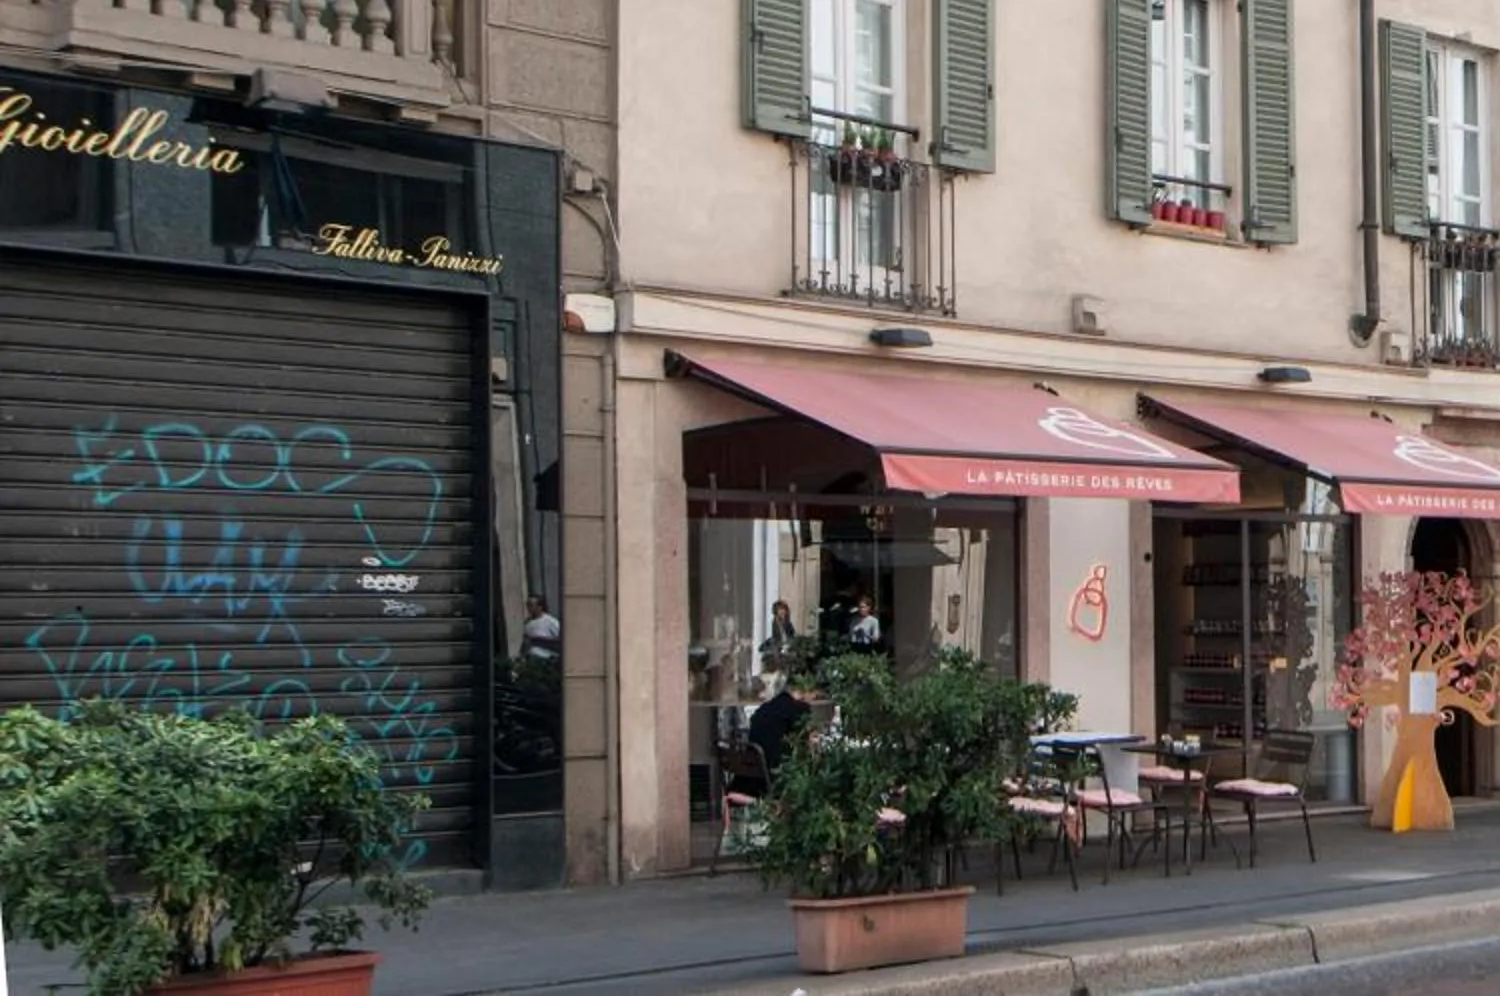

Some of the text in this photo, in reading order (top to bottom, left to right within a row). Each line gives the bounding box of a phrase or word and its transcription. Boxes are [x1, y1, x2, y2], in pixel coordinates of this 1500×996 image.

[966, 468, 988, 484] LA
[1091, 474, 1120, 490] DES
[1376, 493, 1394, 506] LA
